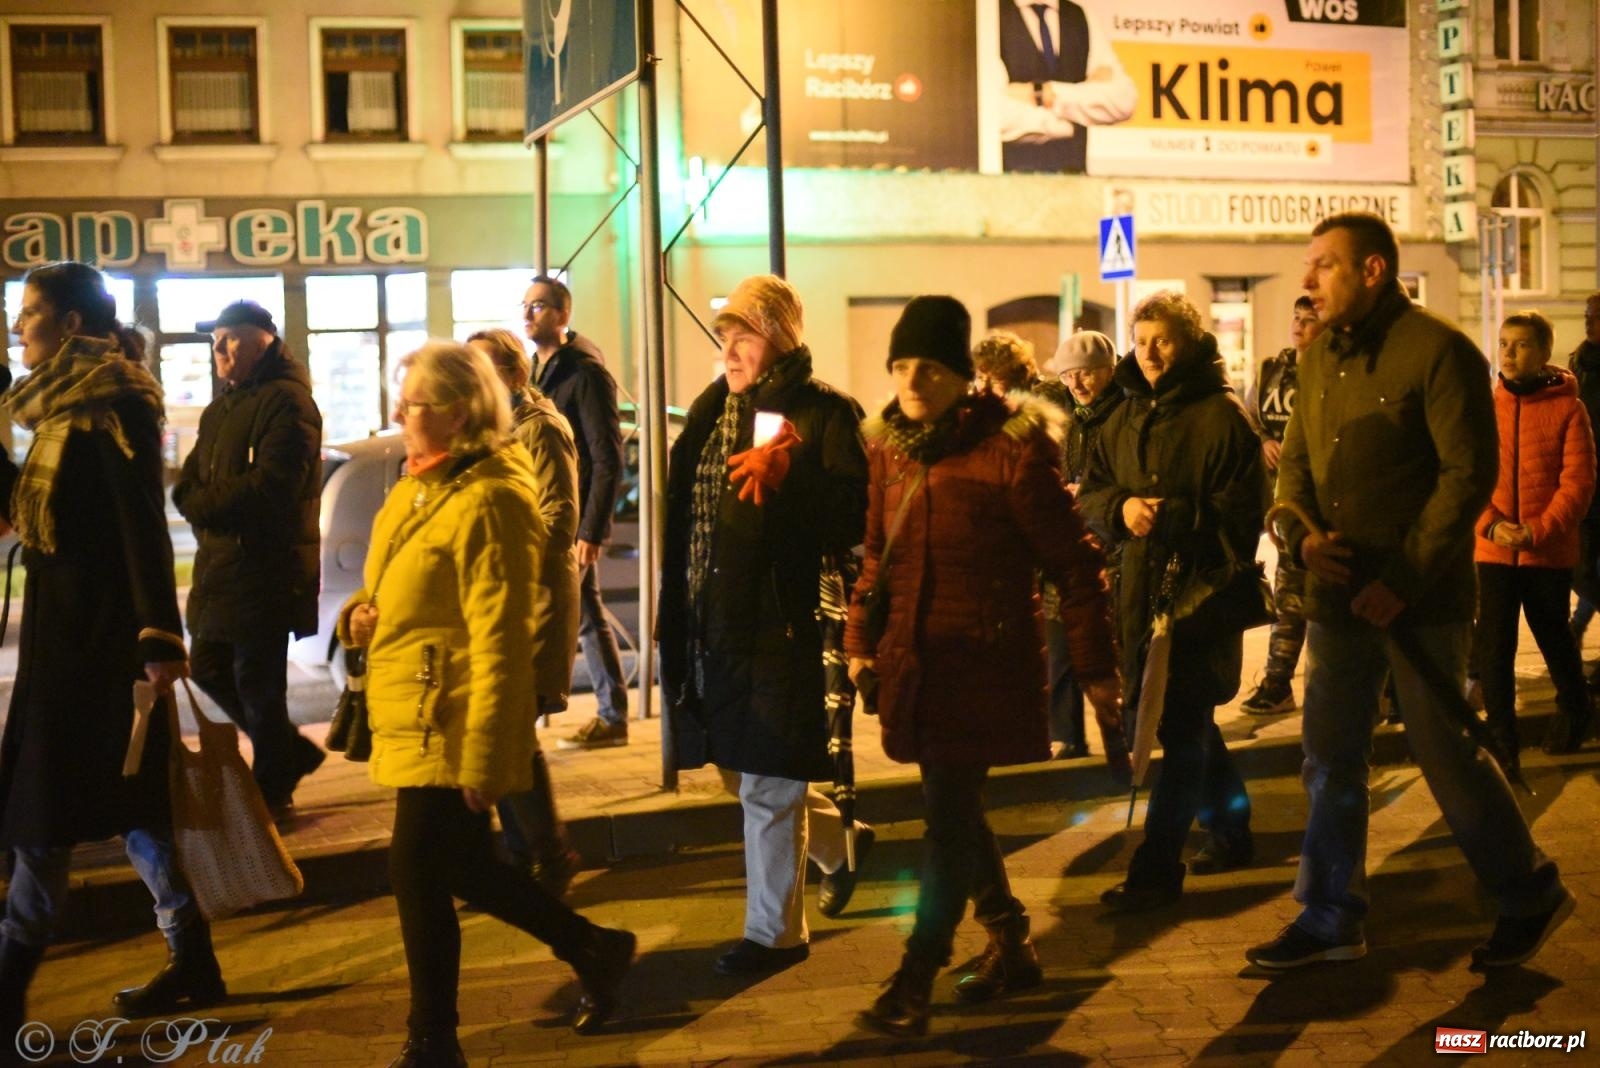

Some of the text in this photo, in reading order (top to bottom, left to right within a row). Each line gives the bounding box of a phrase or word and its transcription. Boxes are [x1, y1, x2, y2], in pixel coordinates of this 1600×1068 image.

[1114, 15, 1240, 36] Lepszy Powiat
[1151, 58, 1343, 126] Klima
[1440, 0, 1465, 234] PTEKA
[1149, 191, 1222, 225] STUDIO
